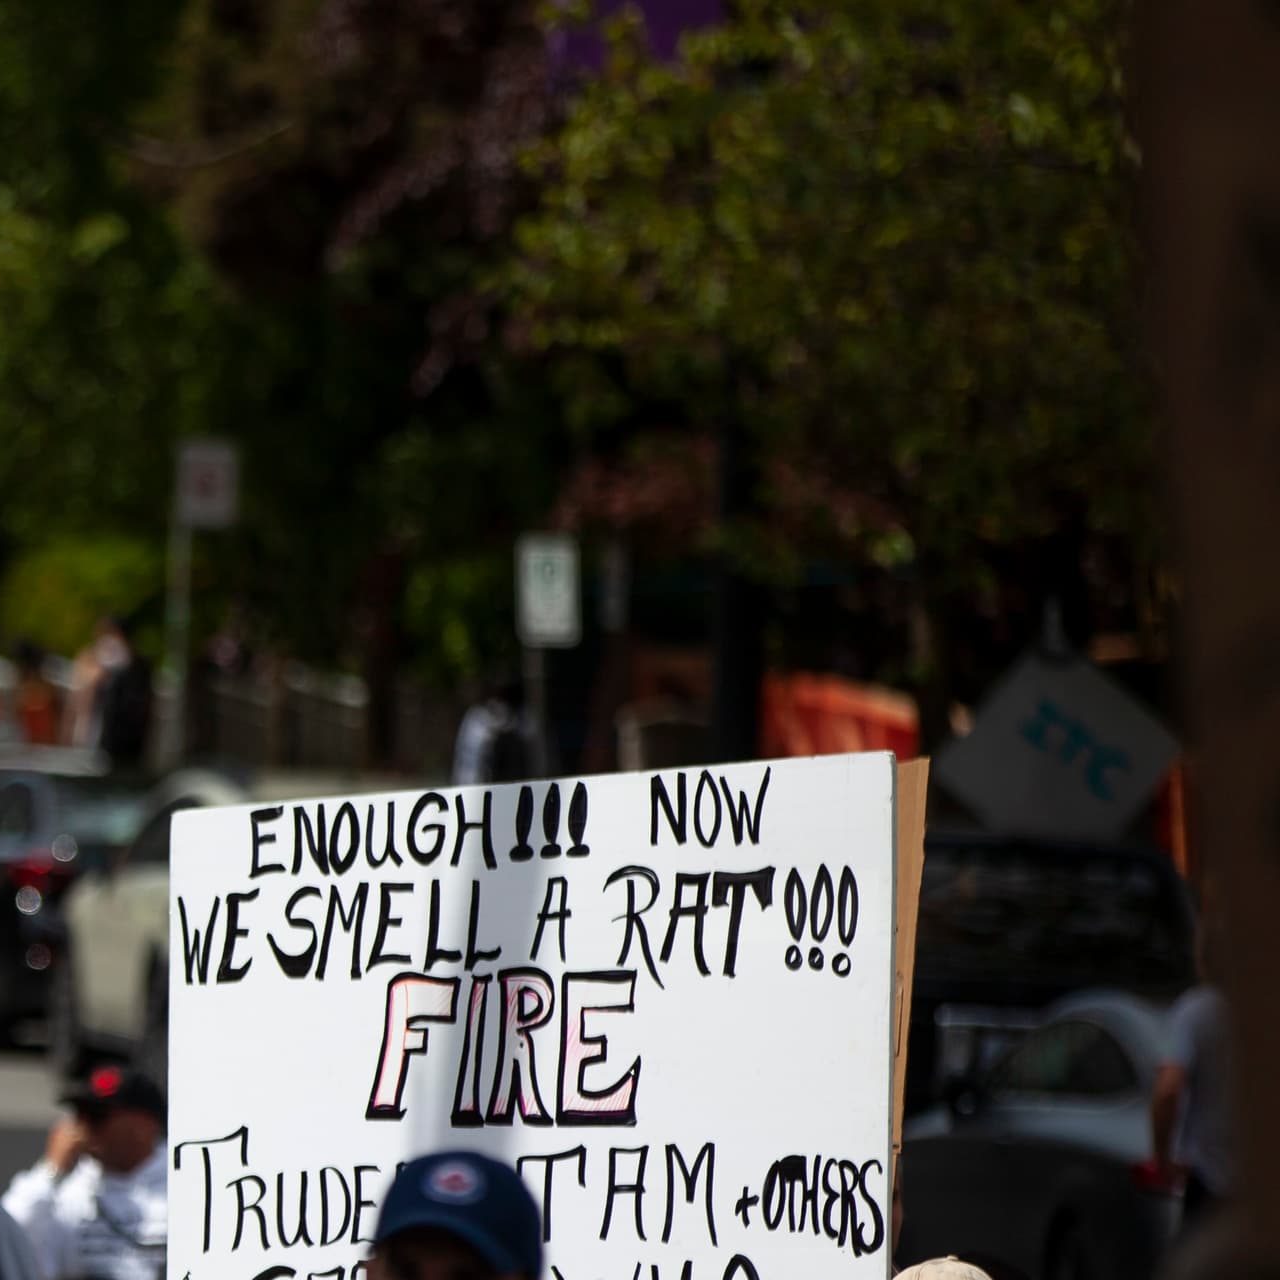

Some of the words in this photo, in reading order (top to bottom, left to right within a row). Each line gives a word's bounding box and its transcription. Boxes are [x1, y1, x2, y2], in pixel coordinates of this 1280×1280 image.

[249, 781, 590, 878] ENOUGH!!!
[651, 766, 771, 847] NOW
[531, 877, 572, 962] A
[365, 969, 641, 1127] FIRE
[174, 1126, 402, 1254] TRUDE
